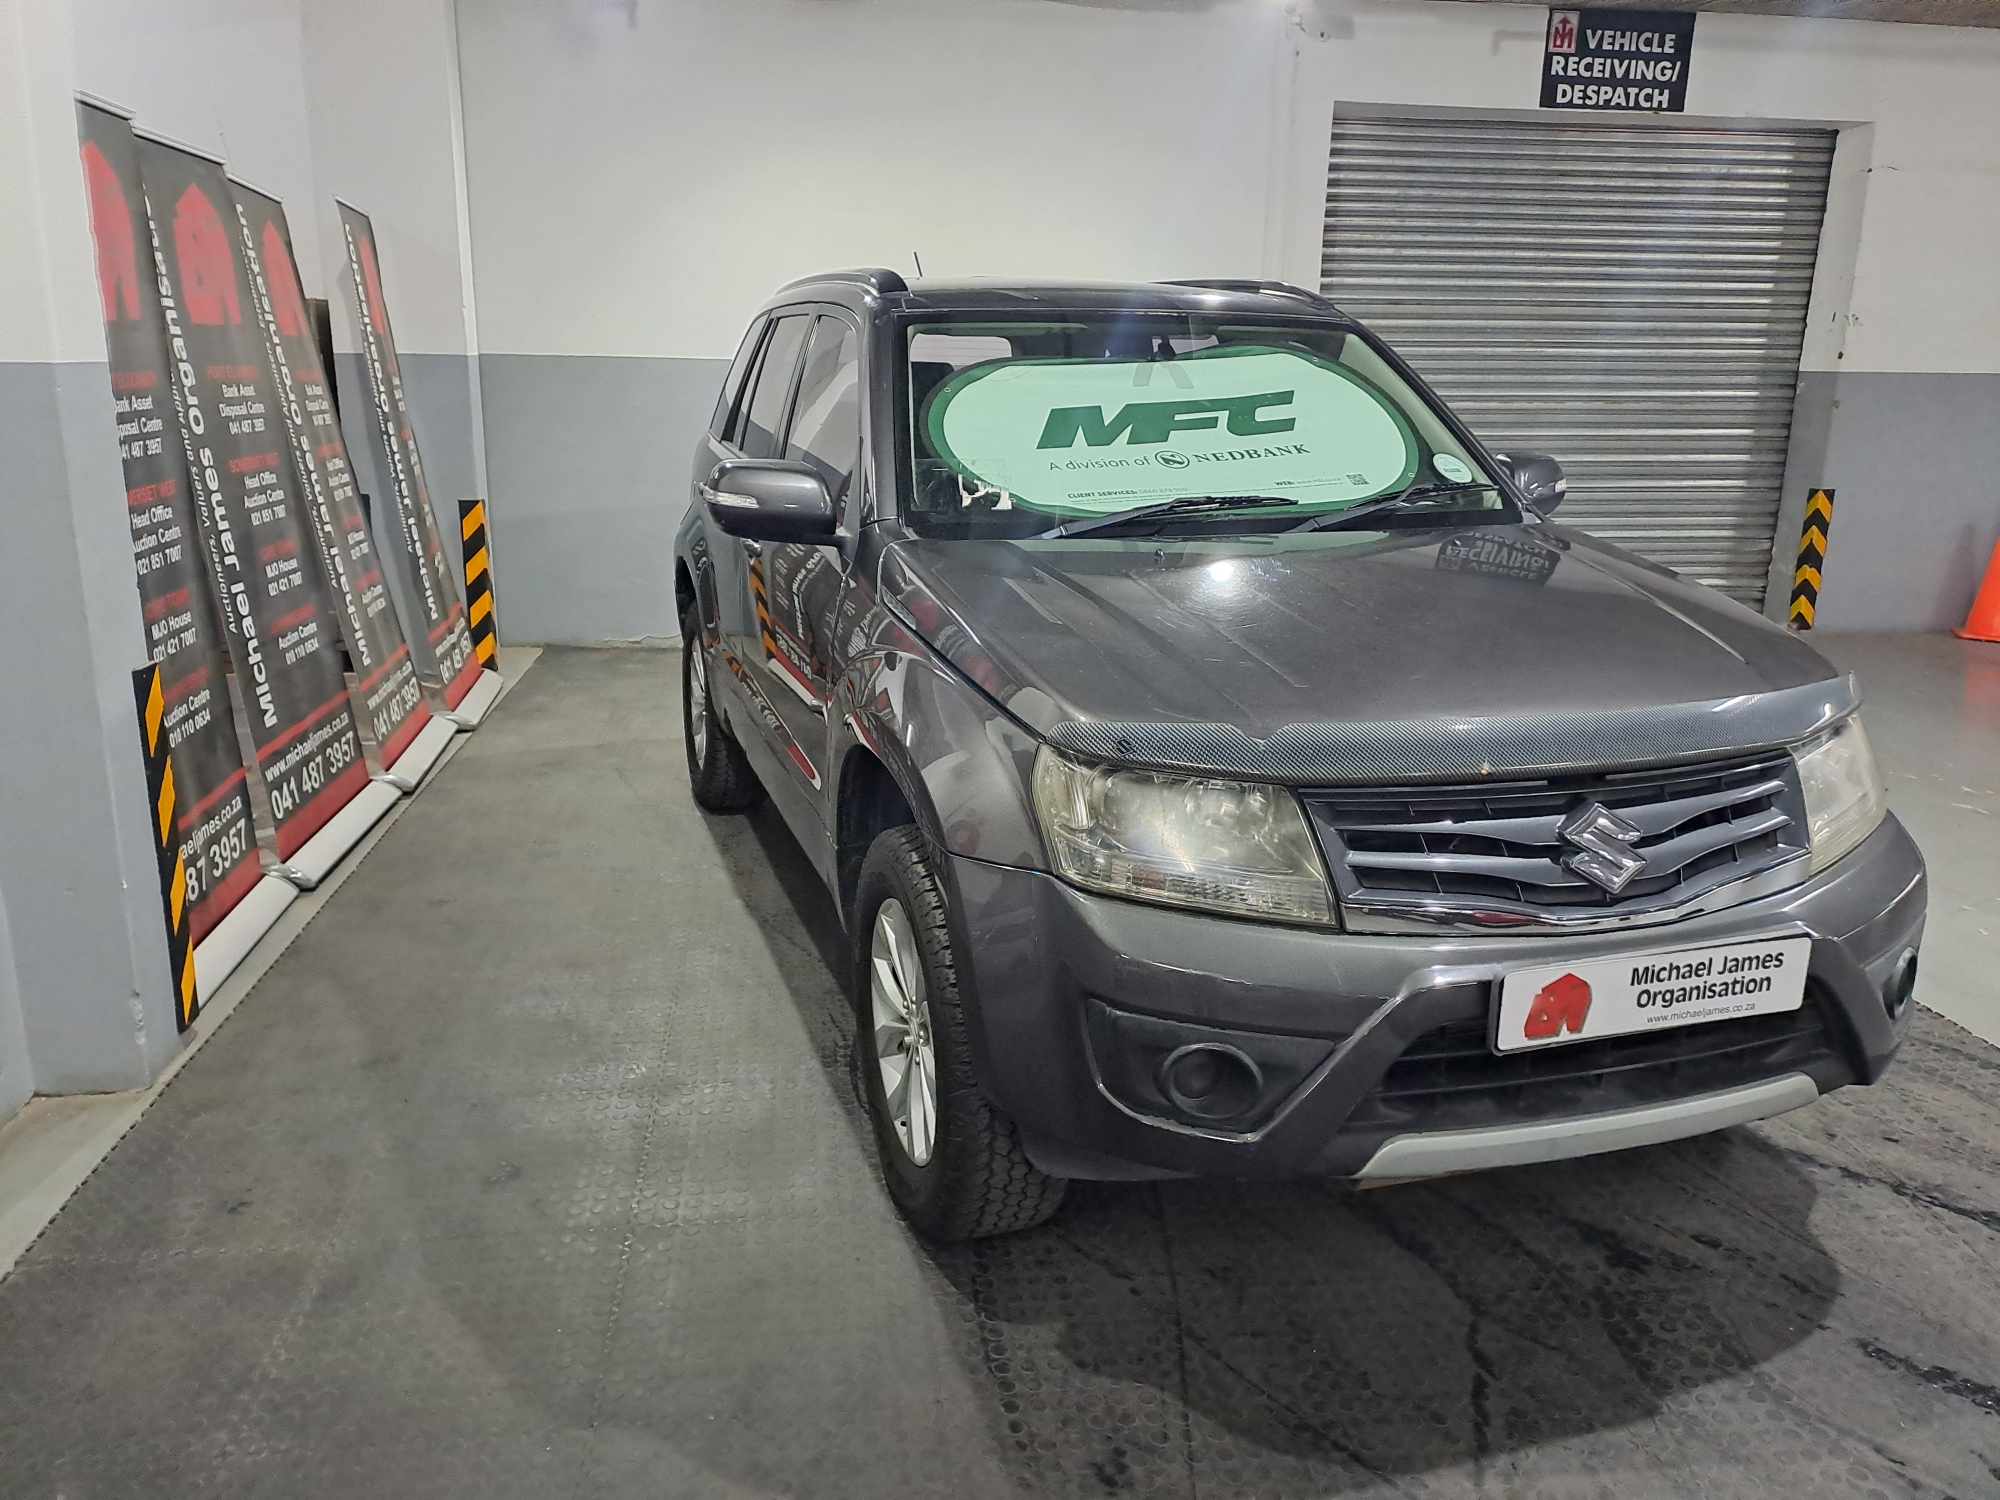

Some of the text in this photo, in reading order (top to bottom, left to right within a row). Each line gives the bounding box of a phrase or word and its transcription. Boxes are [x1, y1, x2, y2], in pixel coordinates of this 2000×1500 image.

[1586, 29, 1676, 54] VEHICLE
[1551, 56, 1682, 82] RECEIVING/
[1556, 83, 1670, 109] DESPATCH
[142, 183, 205, 435] Organisa
[235, 203, 302, 425] Organisation
[344, 223, 389, 412] Organisation
[132, 395, 154, 411] Asset
[1036, 390, 1296, 449] MFC
[140, 416, 163, 433] Centre
[120, 437, 162, 460] 41 487 3957
[386, 421, 412, 509] James
[1049, 443, 1312, 472] A division of NEDBANK
[301, 434, 335, 536] James
[1067, 491, 1095, 499] CLIENT
[131, 504, 173, 530] Head Office
[200, 447, 241, 572] James
[158, 524, 182, 544] Centre
[180, 429, 238, 633] Auctioneers, Valuers and
[137, 544, 182, 575] 021 851 7007
[407, 517, 439, 620] Michael
[168, 610, 192, 632] House
[330, 547, 371, 666] Michael
[153, 627, 197, 663] 021 421 7007
[231, 582, 278, 728] Michael
[188, 688, 211, 711] Centre
[373, 707, 391, 741] 041
[389, 693, 405, 724] 487
[169, 727, 182, 748] 010
[182, 718, 194, 738] 110
[265, 711, 350, 782] www.michaeljames.co.za
[271, 730, 355, 819] 041 487 3957
[179, 795, 242, 860] aeljames.co.za
[186, 817, 246, 903] 87 3957
[1630, 951, 1785, 987] Michael James
[1636, 974, 1772, 1009] Organisation
[1647, 1003, 1756, 1023] www.michaeljames.co.za
